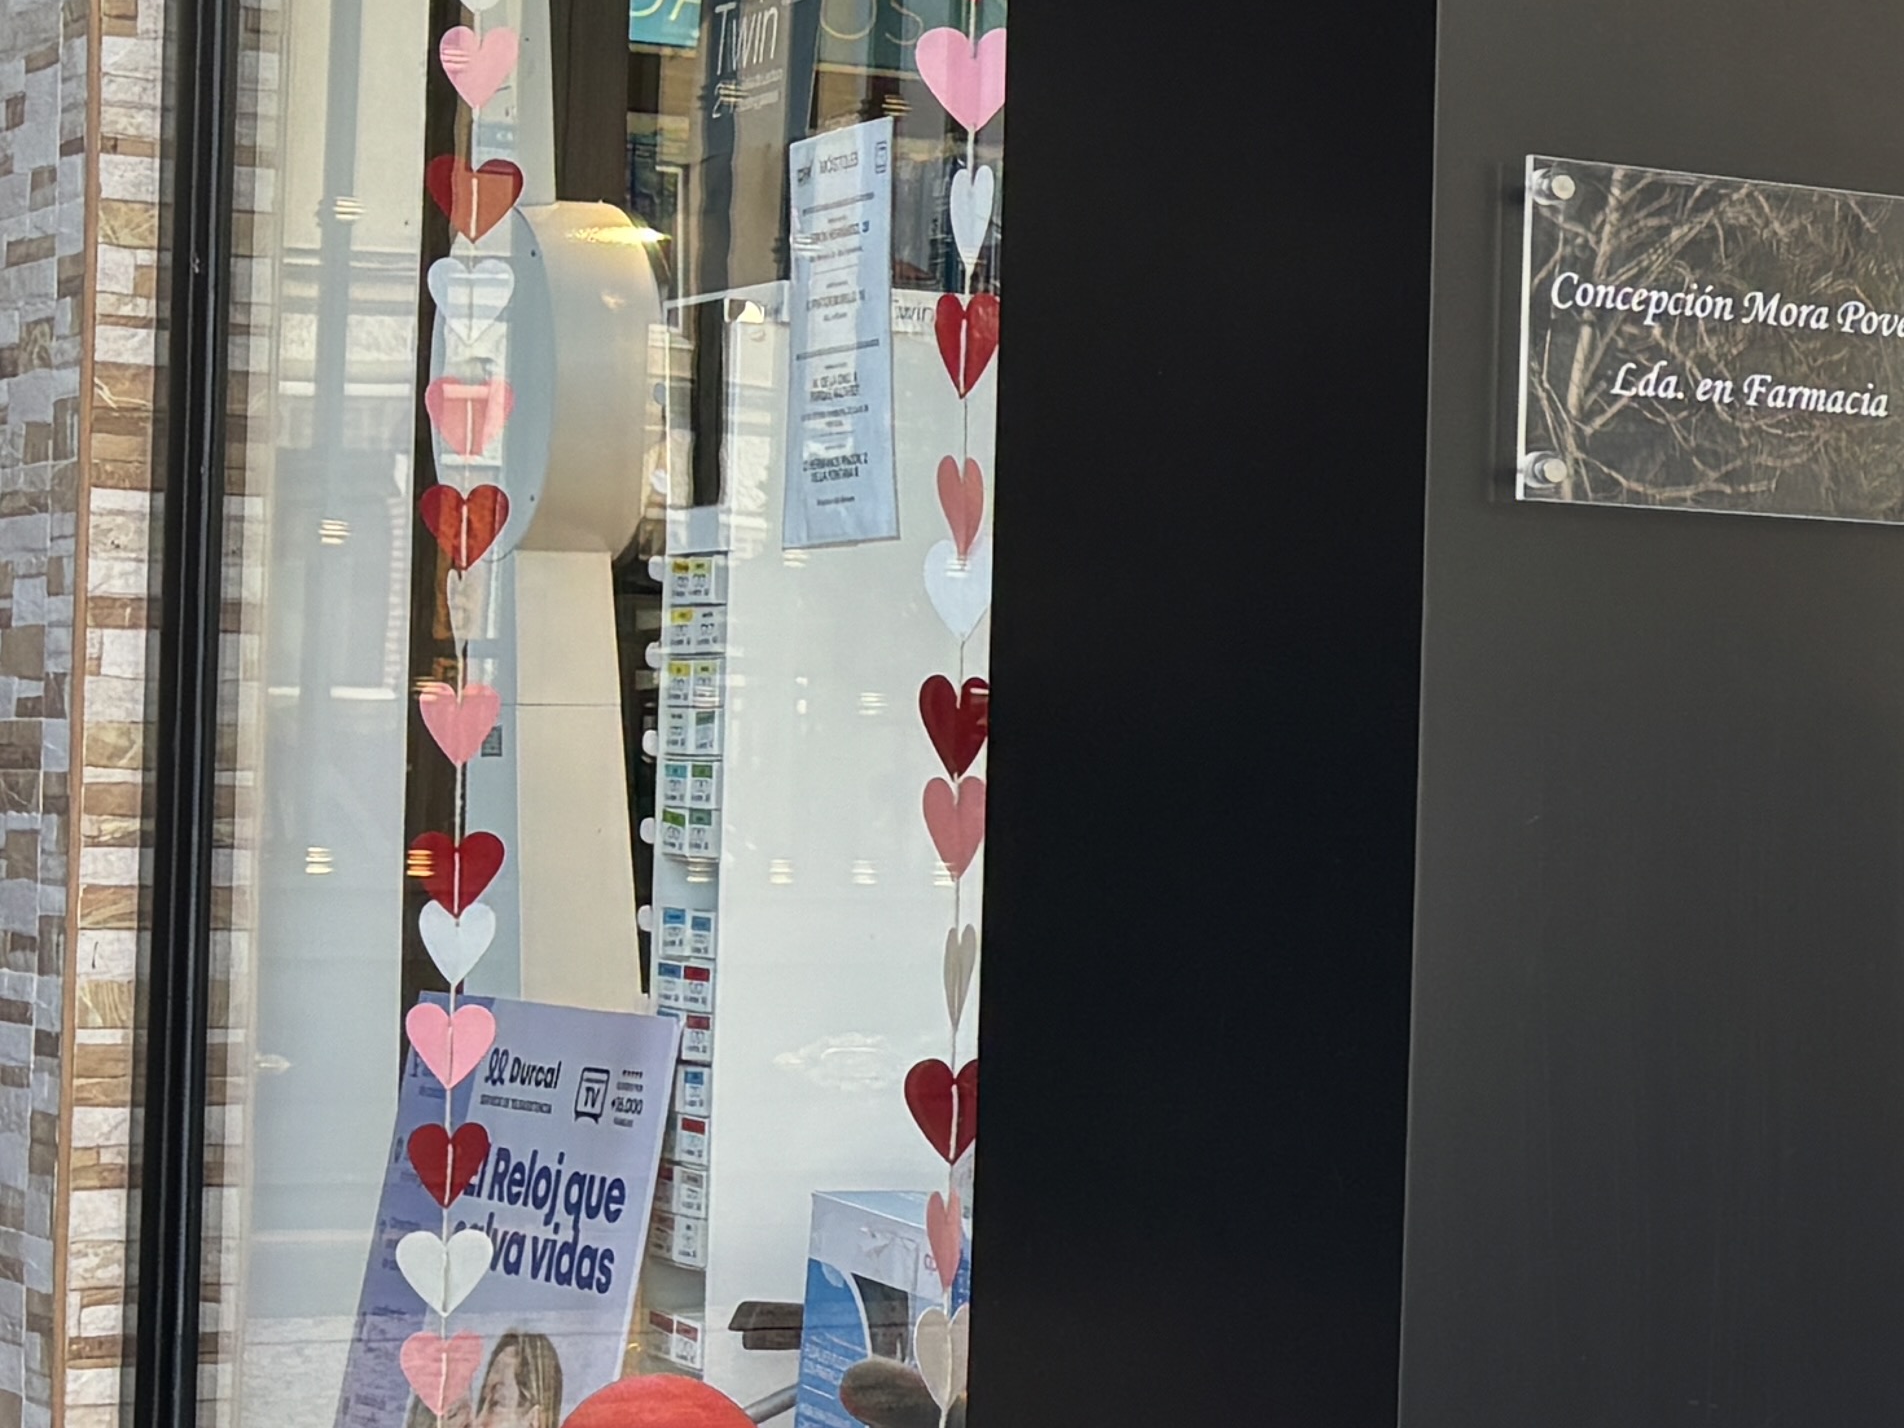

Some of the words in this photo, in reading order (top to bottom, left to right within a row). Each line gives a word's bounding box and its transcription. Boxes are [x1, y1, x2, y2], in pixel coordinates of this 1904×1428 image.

[1551, 272, 1735, 322] Concepción
[1741, 292, 1830, 332] Mora
[1611, 360, 1685, 400] Lda.
[1696, 377, 1734, 405] en
[1743, 374, 1889, 418] Farmacia
[510, 1056, 562, 1089] Durcal
[583, 1086, 601, 1109] TV
[490, 1145, 564, 1225] Reloj
[564, 1164, 626, 1225] que
[531, 1222, 616, 1294] vidas
